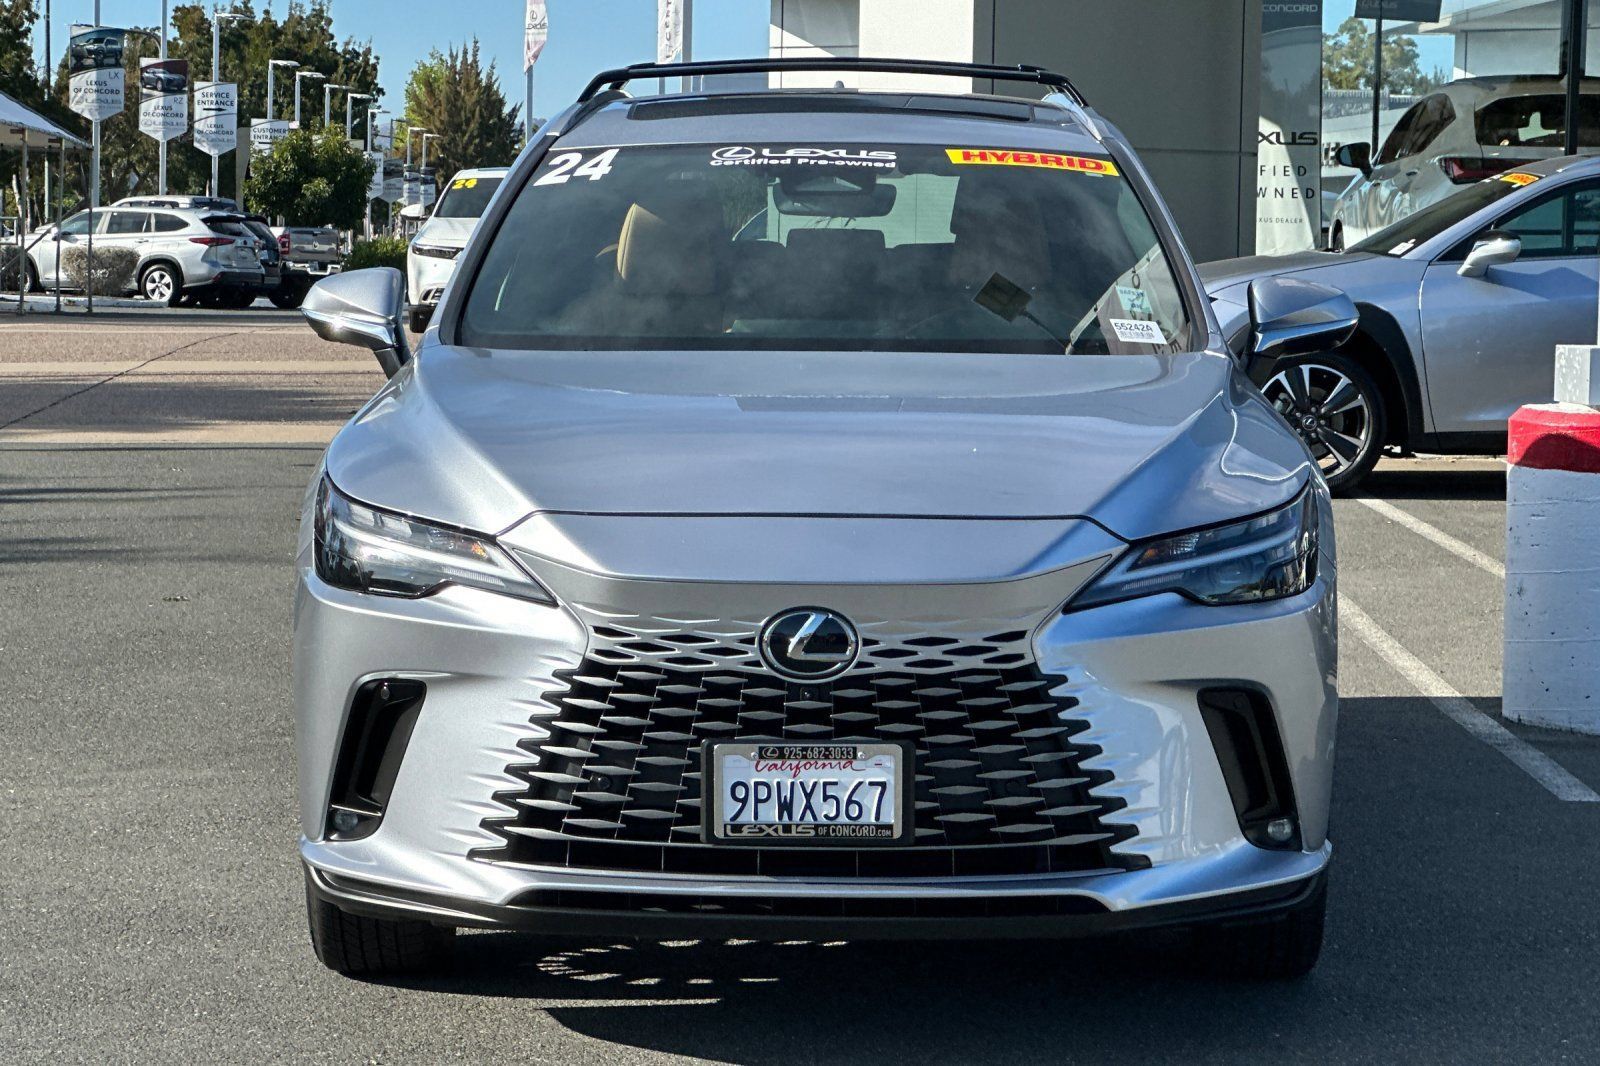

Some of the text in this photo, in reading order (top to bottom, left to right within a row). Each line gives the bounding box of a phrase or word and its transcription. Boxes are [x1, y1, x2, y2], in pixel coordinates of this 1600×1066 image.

[1262, 4, 1319, 13] CONCORD
[108, 71, 120, 80] LX
[83, 87, 121, 95] CONCORD
[201, 91, 231, 99] SERVICE
[173, 96, 184, 105] RZ
[196, 99, 235, 107] ENTRANCE
[151, 111, 184, 119] CONCORD
[204, 129, 235, 137] CONCORD
[761, 147, 898, 161] LEXUS
[709, 157, 897, 169] Certified Pre-owned
[962, 150, 1108, 173] HYBRID
[532, 148, 620, 187] 24
[783, 746, 854, 760] 925-682-3033
[754, 759, 867, 779] California
[729, 780, 888, 822] 9PWX567
[725, 824, 816, 837] LEXUS
[817, 826, 829, 836] OF
